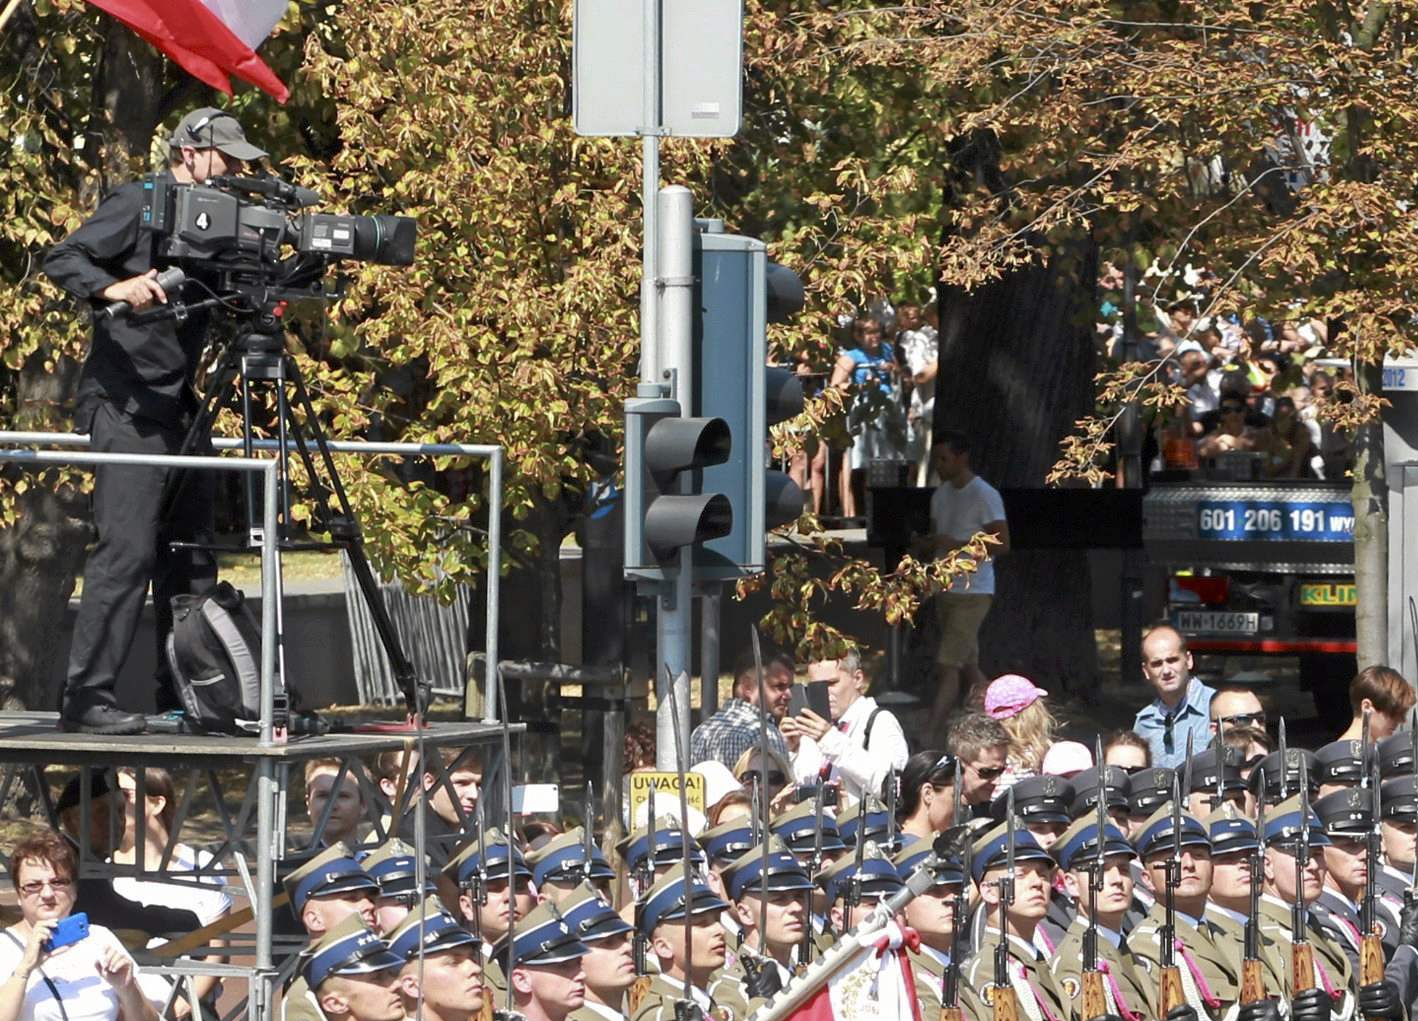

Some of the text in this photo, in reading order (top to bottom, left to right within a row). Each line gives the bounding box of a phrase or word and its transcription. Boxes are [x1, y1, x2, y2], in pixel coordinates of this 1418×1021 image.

[197, 212, 208, 229] 4
[1201, 509, 1235, 531] 601
[1244, 509, 1282, 531] 206
[1290, 509, 1325, 531] 191
[1180, 613, 1257, 631] WW 1669H
